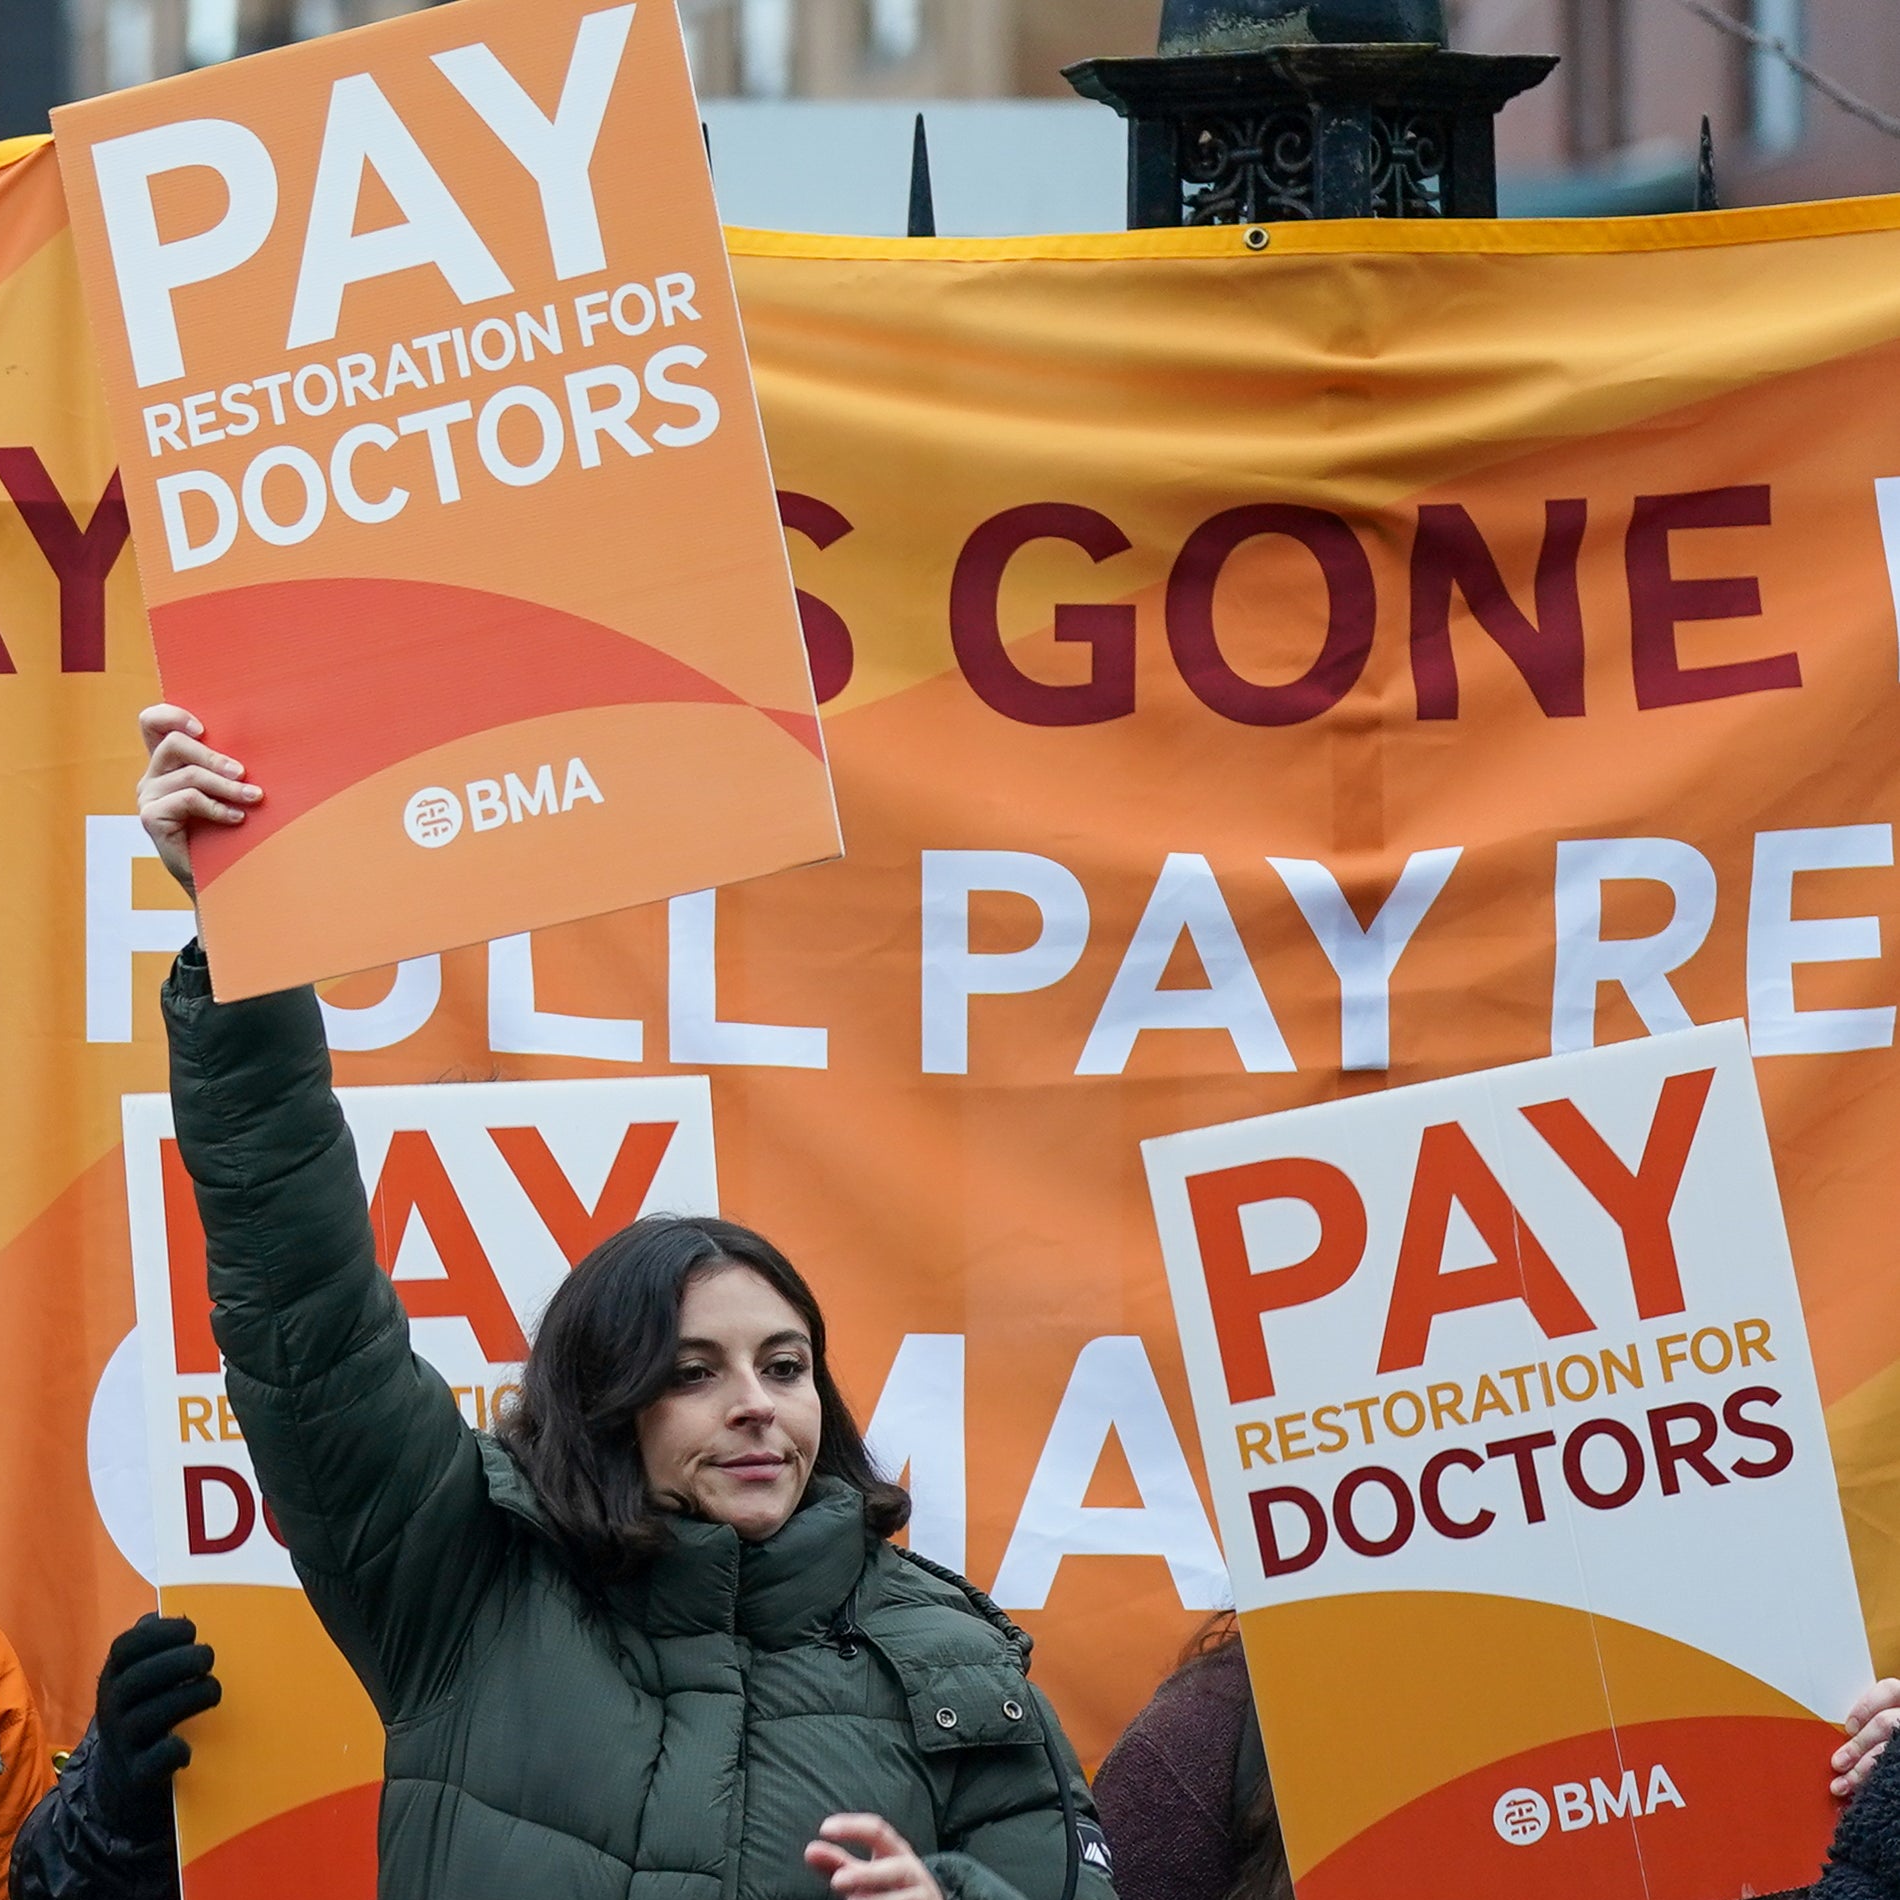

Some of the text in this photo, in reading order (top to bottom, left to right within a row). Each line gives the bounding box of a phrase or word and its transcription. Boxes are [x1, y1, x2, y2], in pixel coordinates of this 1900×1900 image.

[91, 2, 637, 389] PAY
[142, 271, 702, 458] RESTORATION FOR
[155, 344, 721, 574] DOCTORS
[947, 482, 1805, 728] GONE
[470, 756, 605, 834] BMA
[85, 814, 829, 1070] FLL
[920, 846, 1466, 1075] PAY
[1184, 1066, 1717, 1406] PAY
[1235, 1316, 1777, 1471] RESTORATION FOR
[1247, 1385, 1795, 1580] DOCTORS
[1556, 1762, 1686, 1834] BMA
